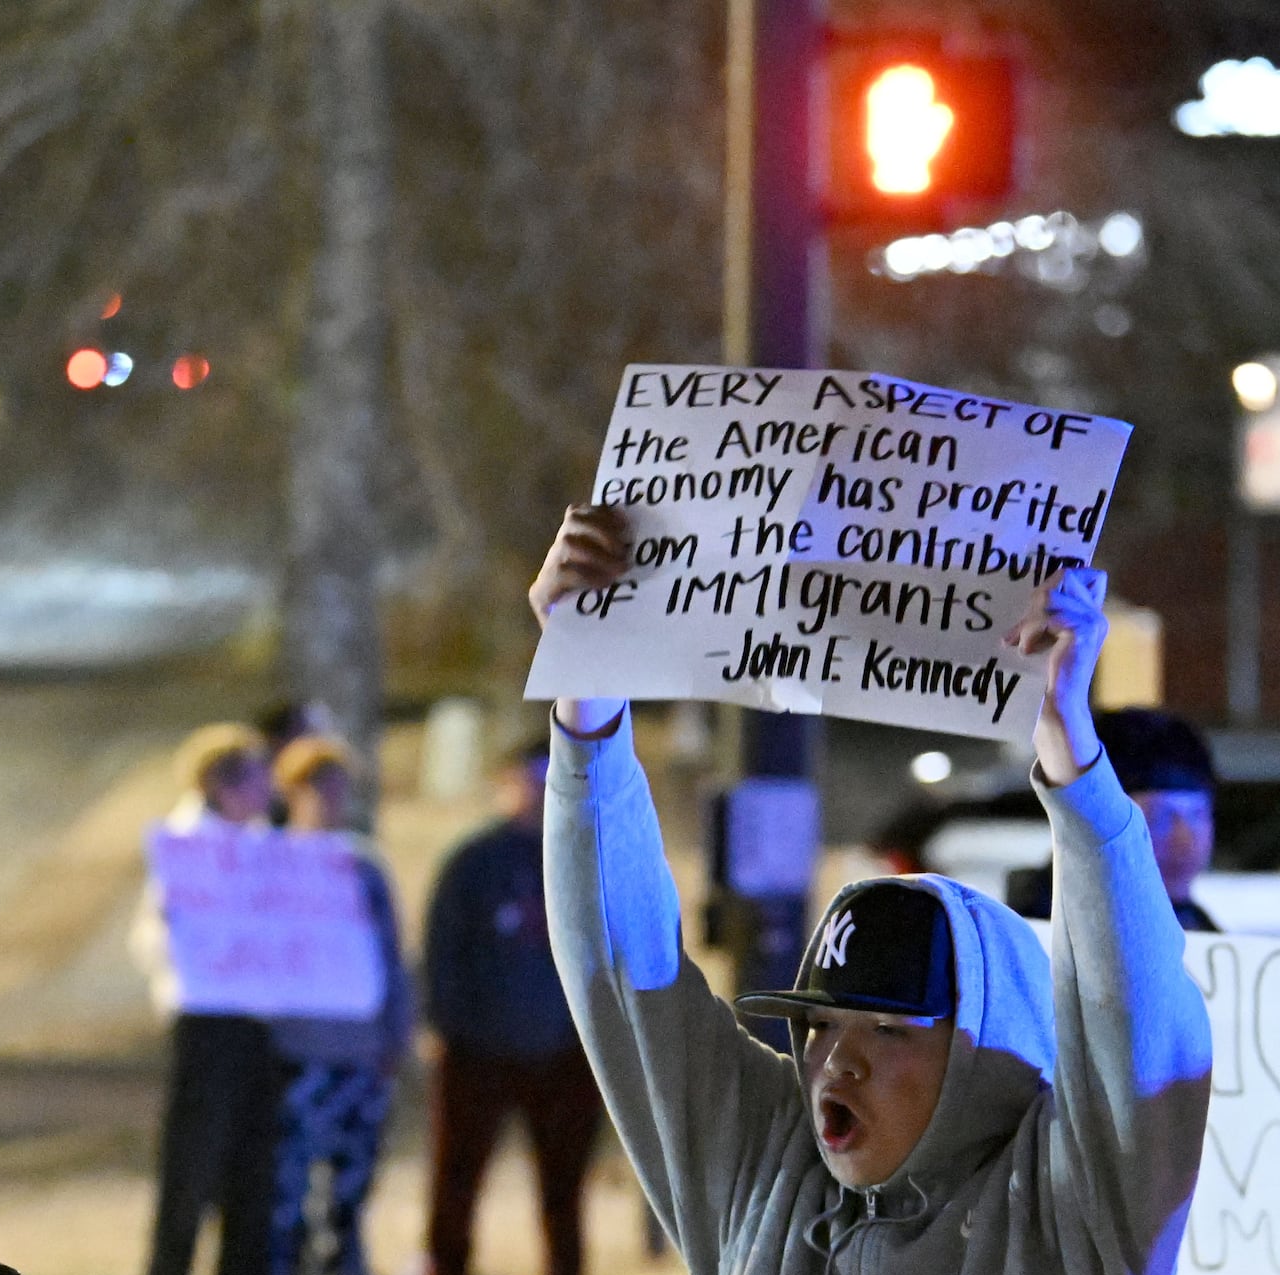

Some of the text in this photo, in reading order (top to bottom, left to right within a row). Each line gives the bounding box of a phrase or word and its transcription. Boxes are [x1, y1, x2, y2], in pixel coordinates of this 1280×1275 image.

[625, 372, 1093, 450] EVERY ASPECT OF
[612, 419, 960, 472] the American
[601, 463, 794, 514] economy
[816, 462, 904, 516] has
[720, 513, 816, 561] the
[860, 638, 1021, 725] Kennedy
